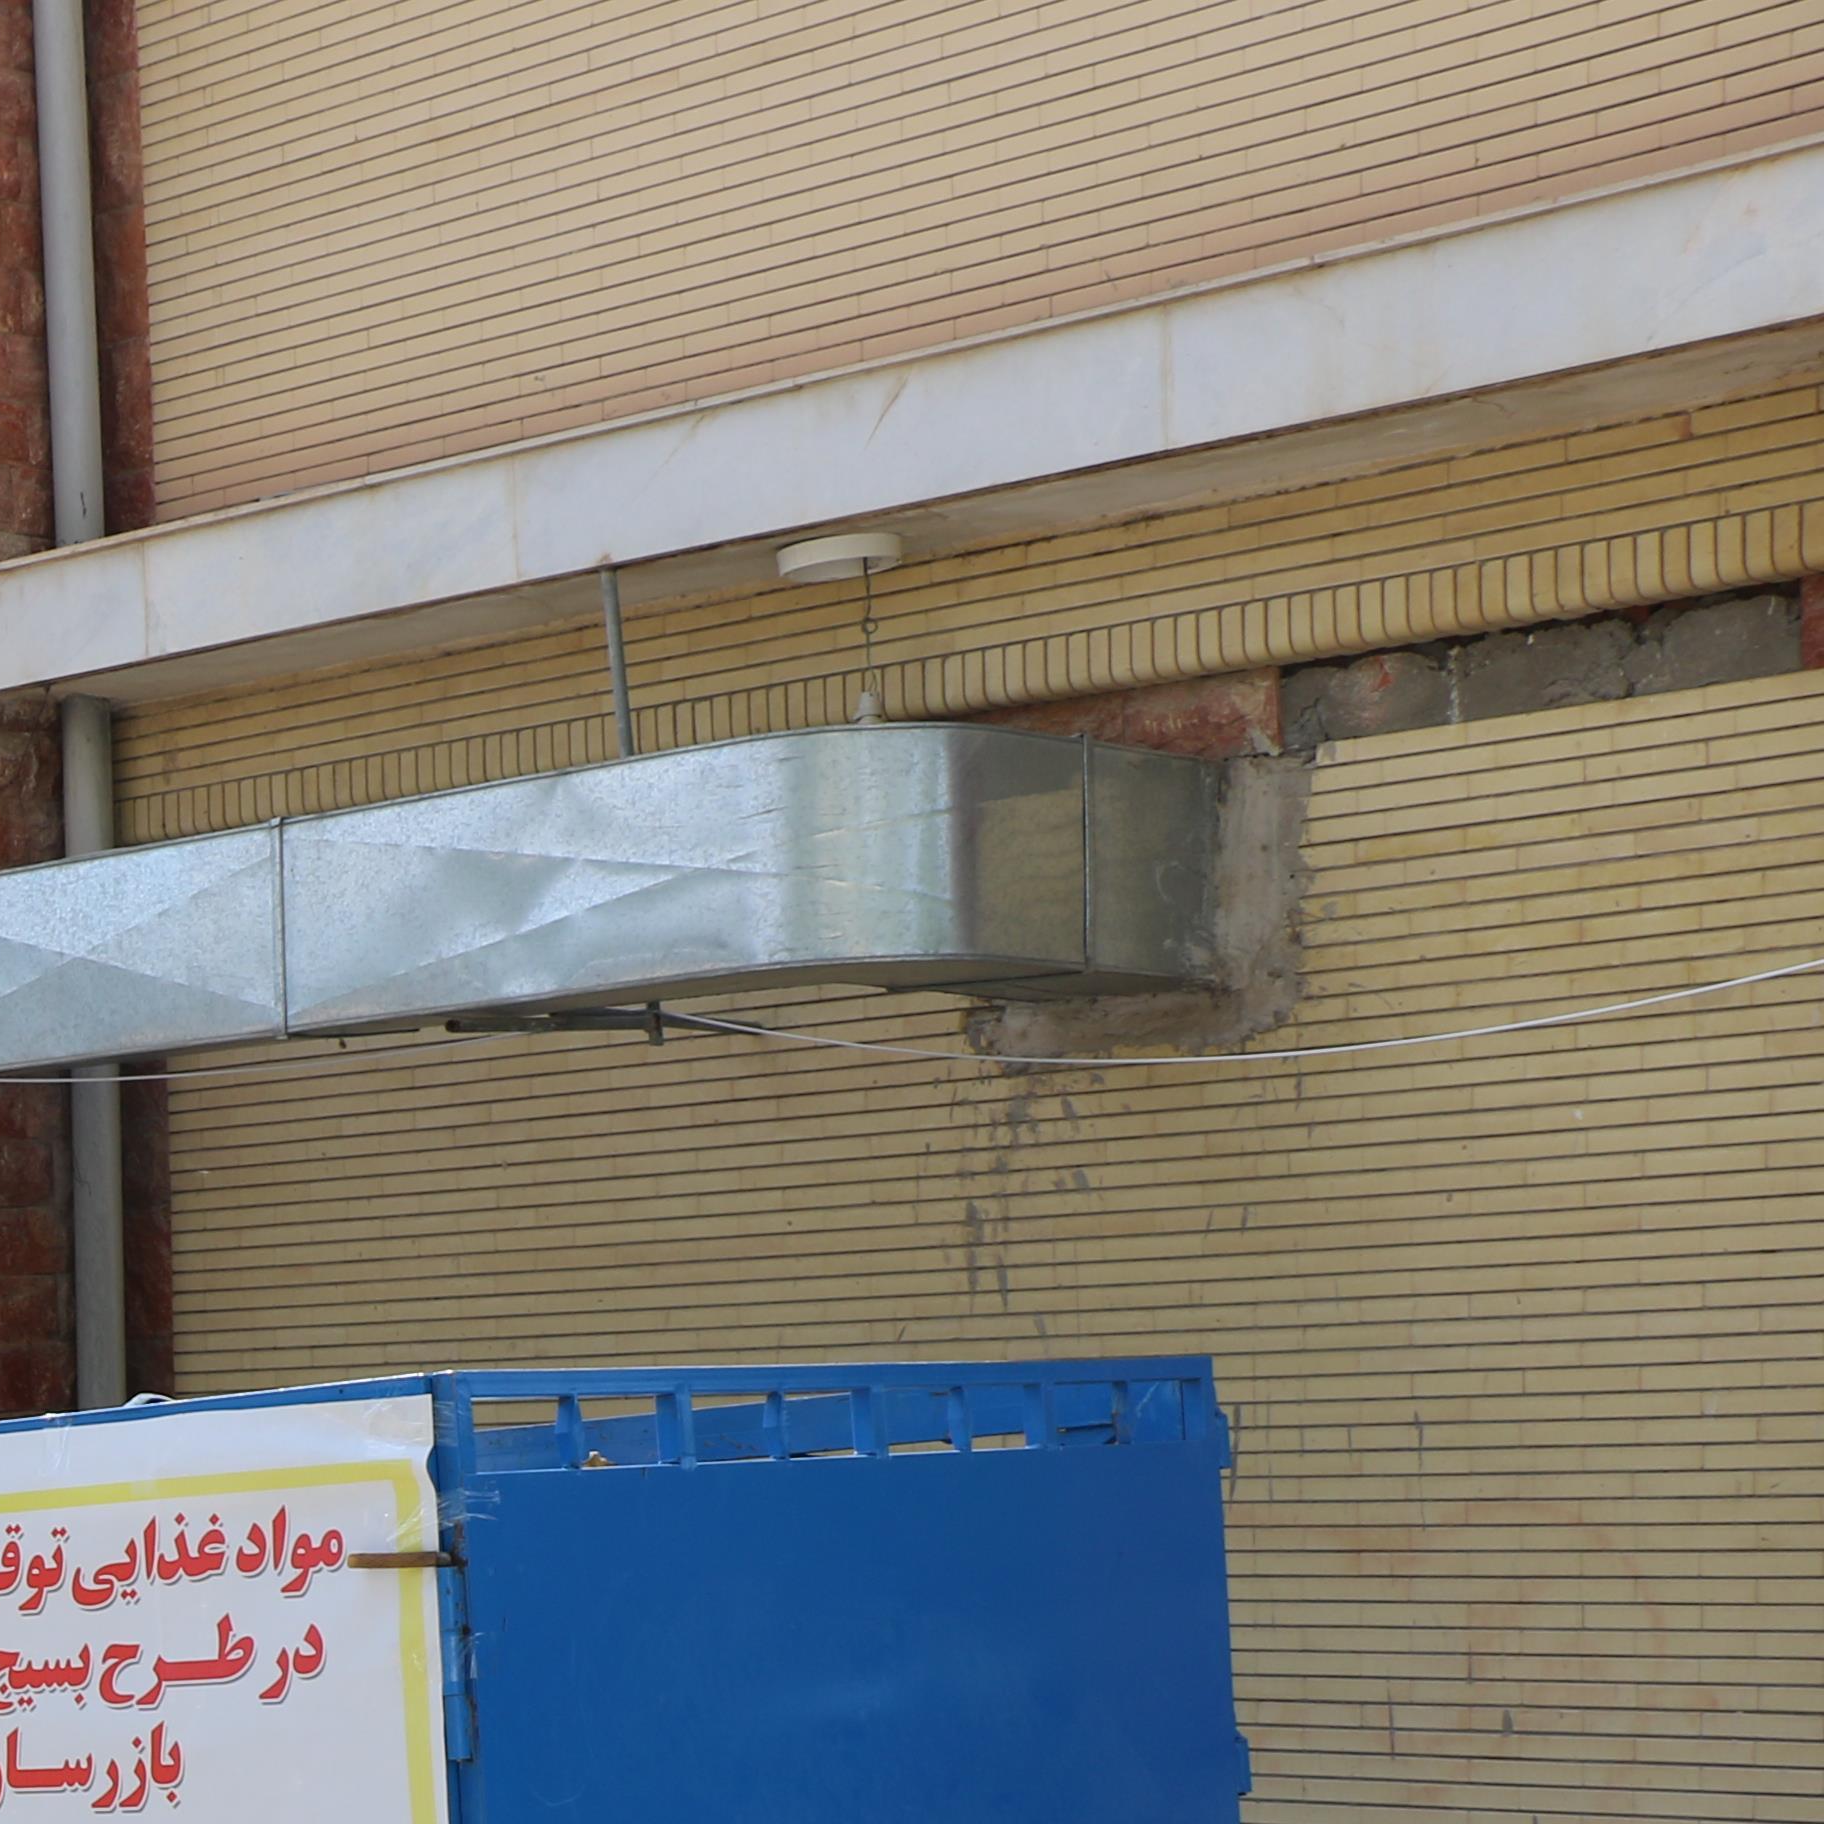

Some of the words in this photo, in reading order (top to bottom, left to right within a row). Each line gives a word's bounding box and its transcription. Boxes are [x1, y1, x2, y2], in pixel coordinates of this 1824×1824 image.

[71, 1512, 228, 1606] غذایی
[235, 1505, 344, 1594] مواد
[99, 1613, 255, 1707] طرح
[258, 1623, 324, 1700] در
